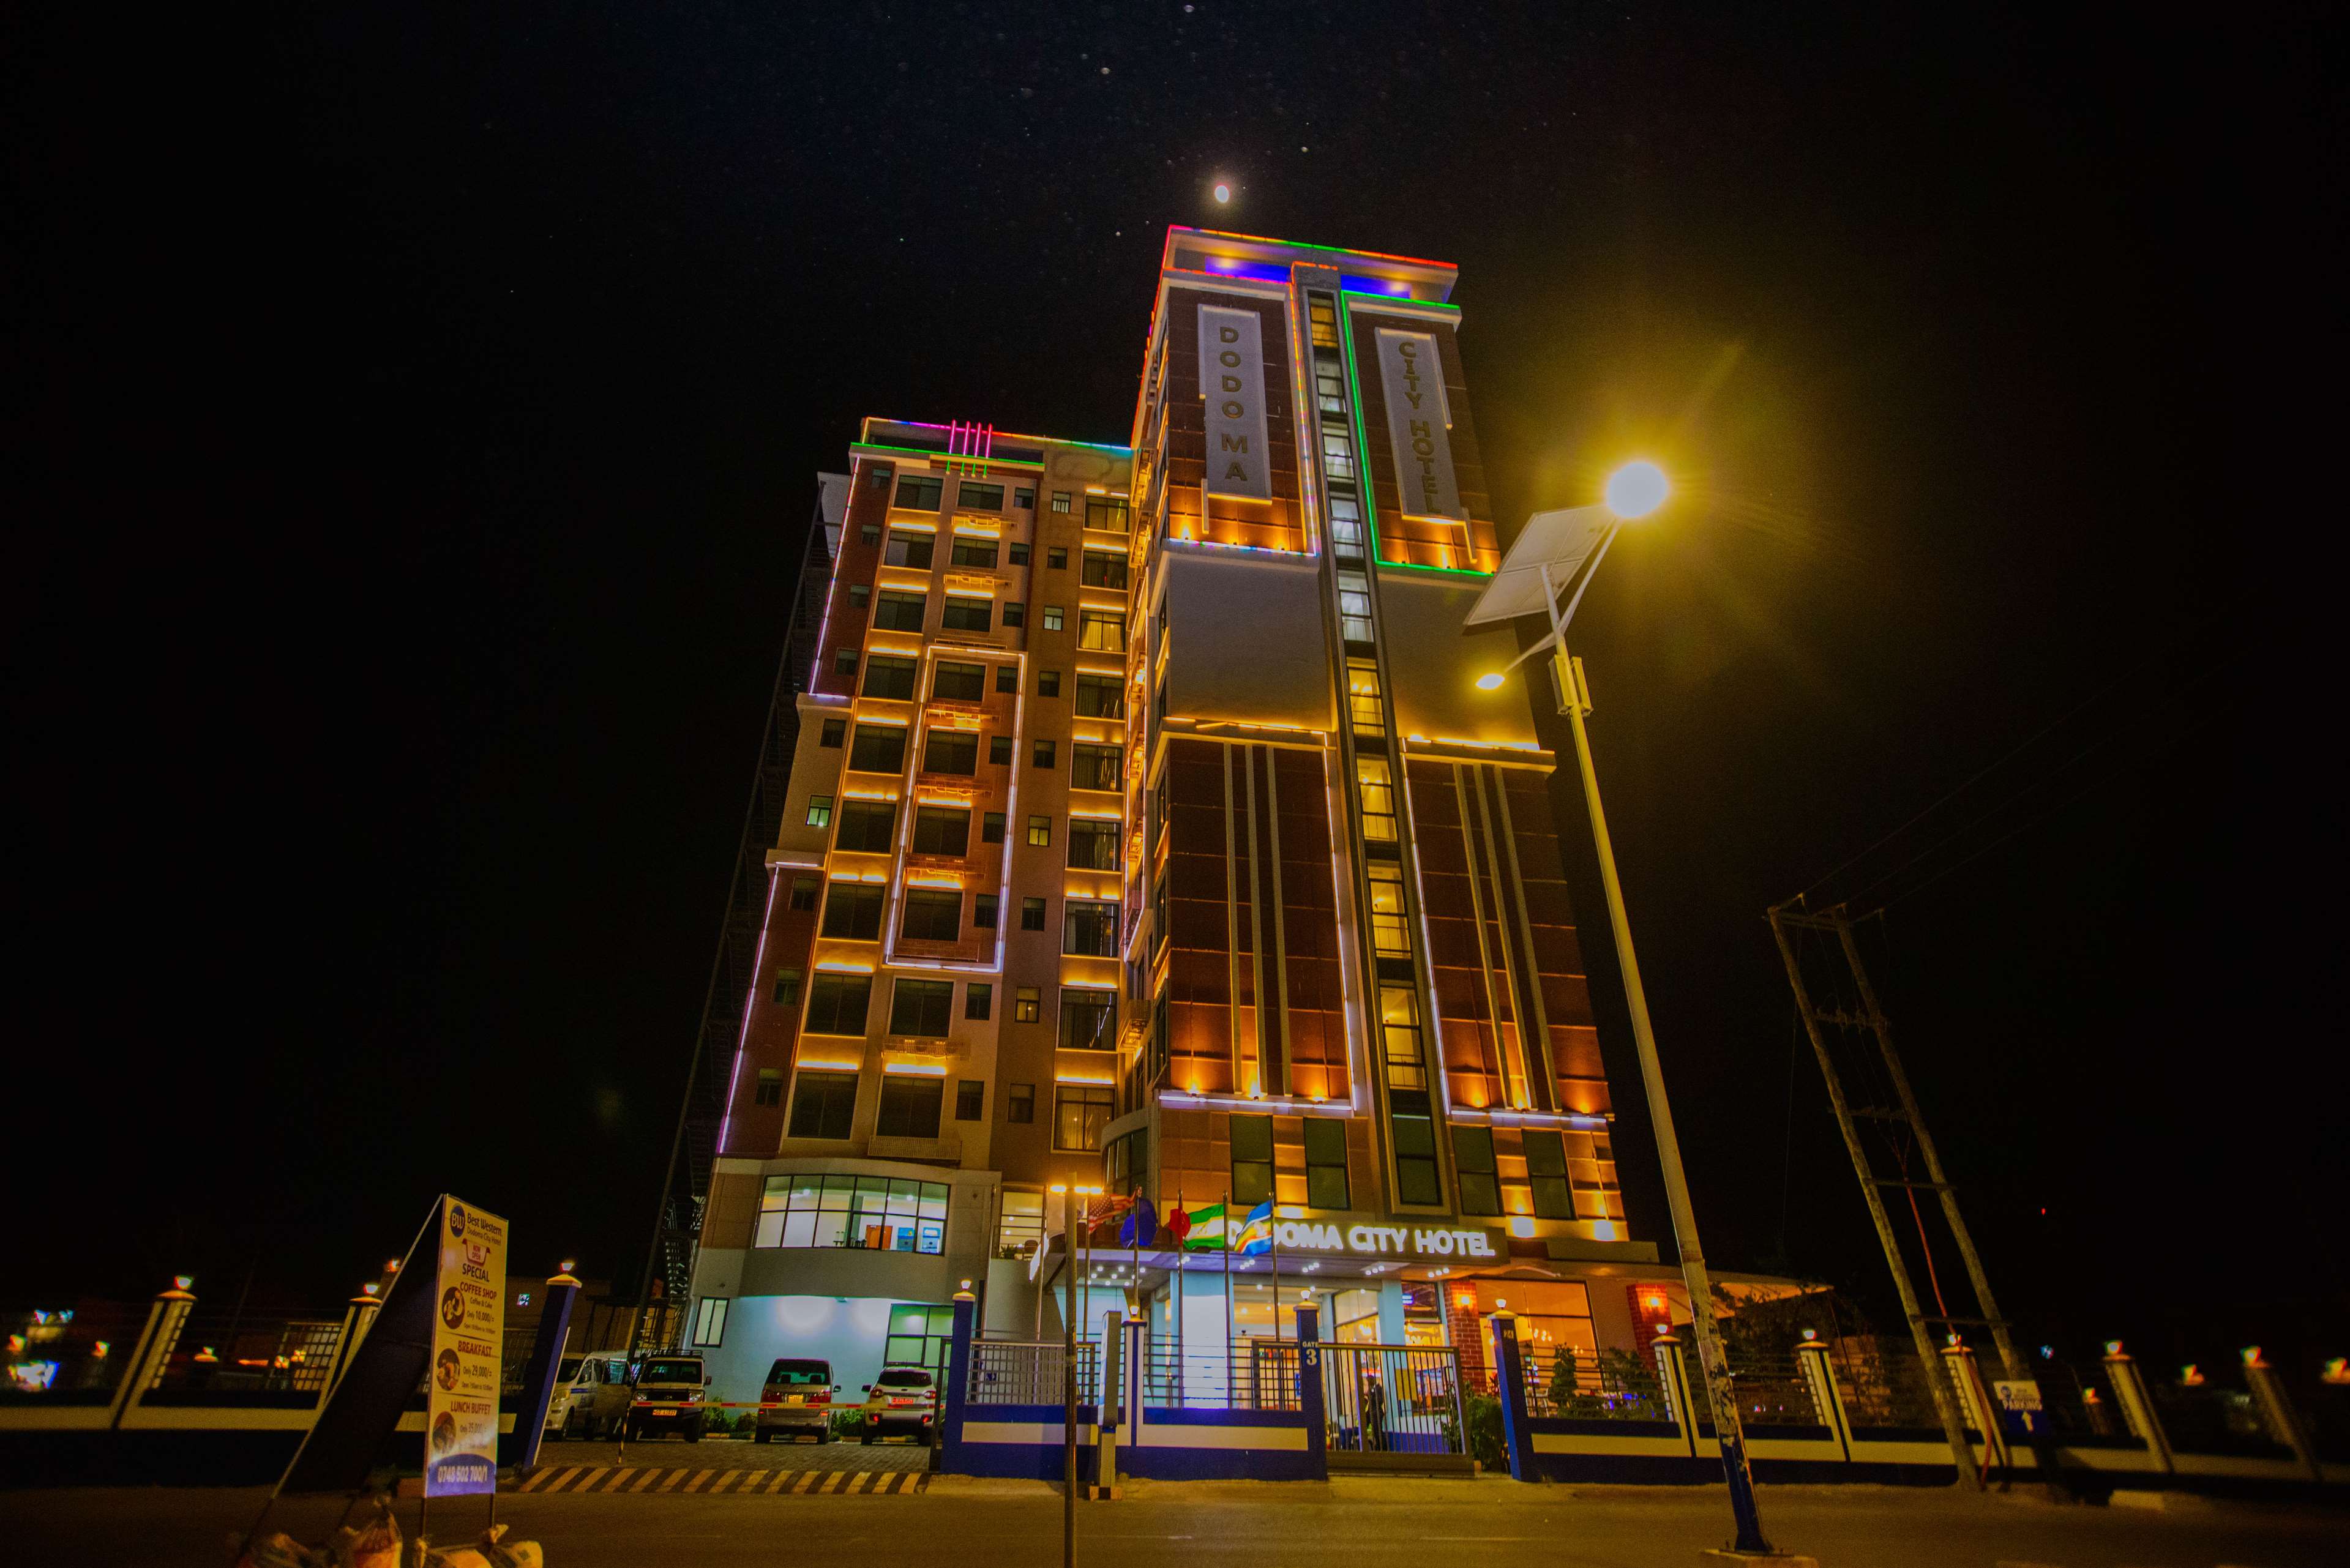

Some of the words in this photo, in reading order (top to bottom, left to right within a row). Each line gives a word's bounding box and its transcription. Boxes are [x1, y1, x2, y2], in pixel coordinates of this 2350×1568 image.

[1399, 342, 1422, 409] CITY
[1220, 327, 1248, 481] DODOMA
[1410, 419, 1442, 515] HOTEL
[467, 1212, 479, 1227] Best
[481, 1218, 501, 1236] Western
[1228, 1220, 1343, 1250] DOMA
[1349, 1225, 1407, 1252] CITY
[1415, 1229, 1495, 1256] HOTEL
[462, 1263, 490, 1282] SPECIAL
[460, 1282, 481, 1296] COFFEE
[482, 1288, 497, 1300] SHOP
[458, 1340, 492, 1357] BREAKFAST
[1306, 1348, 1317, 1365] 3
[463, 1366, 472, 1377] Only
[451, 1400, 470, 1413] LUNCH
[471, 1402, 490, 1416] BUFFET
